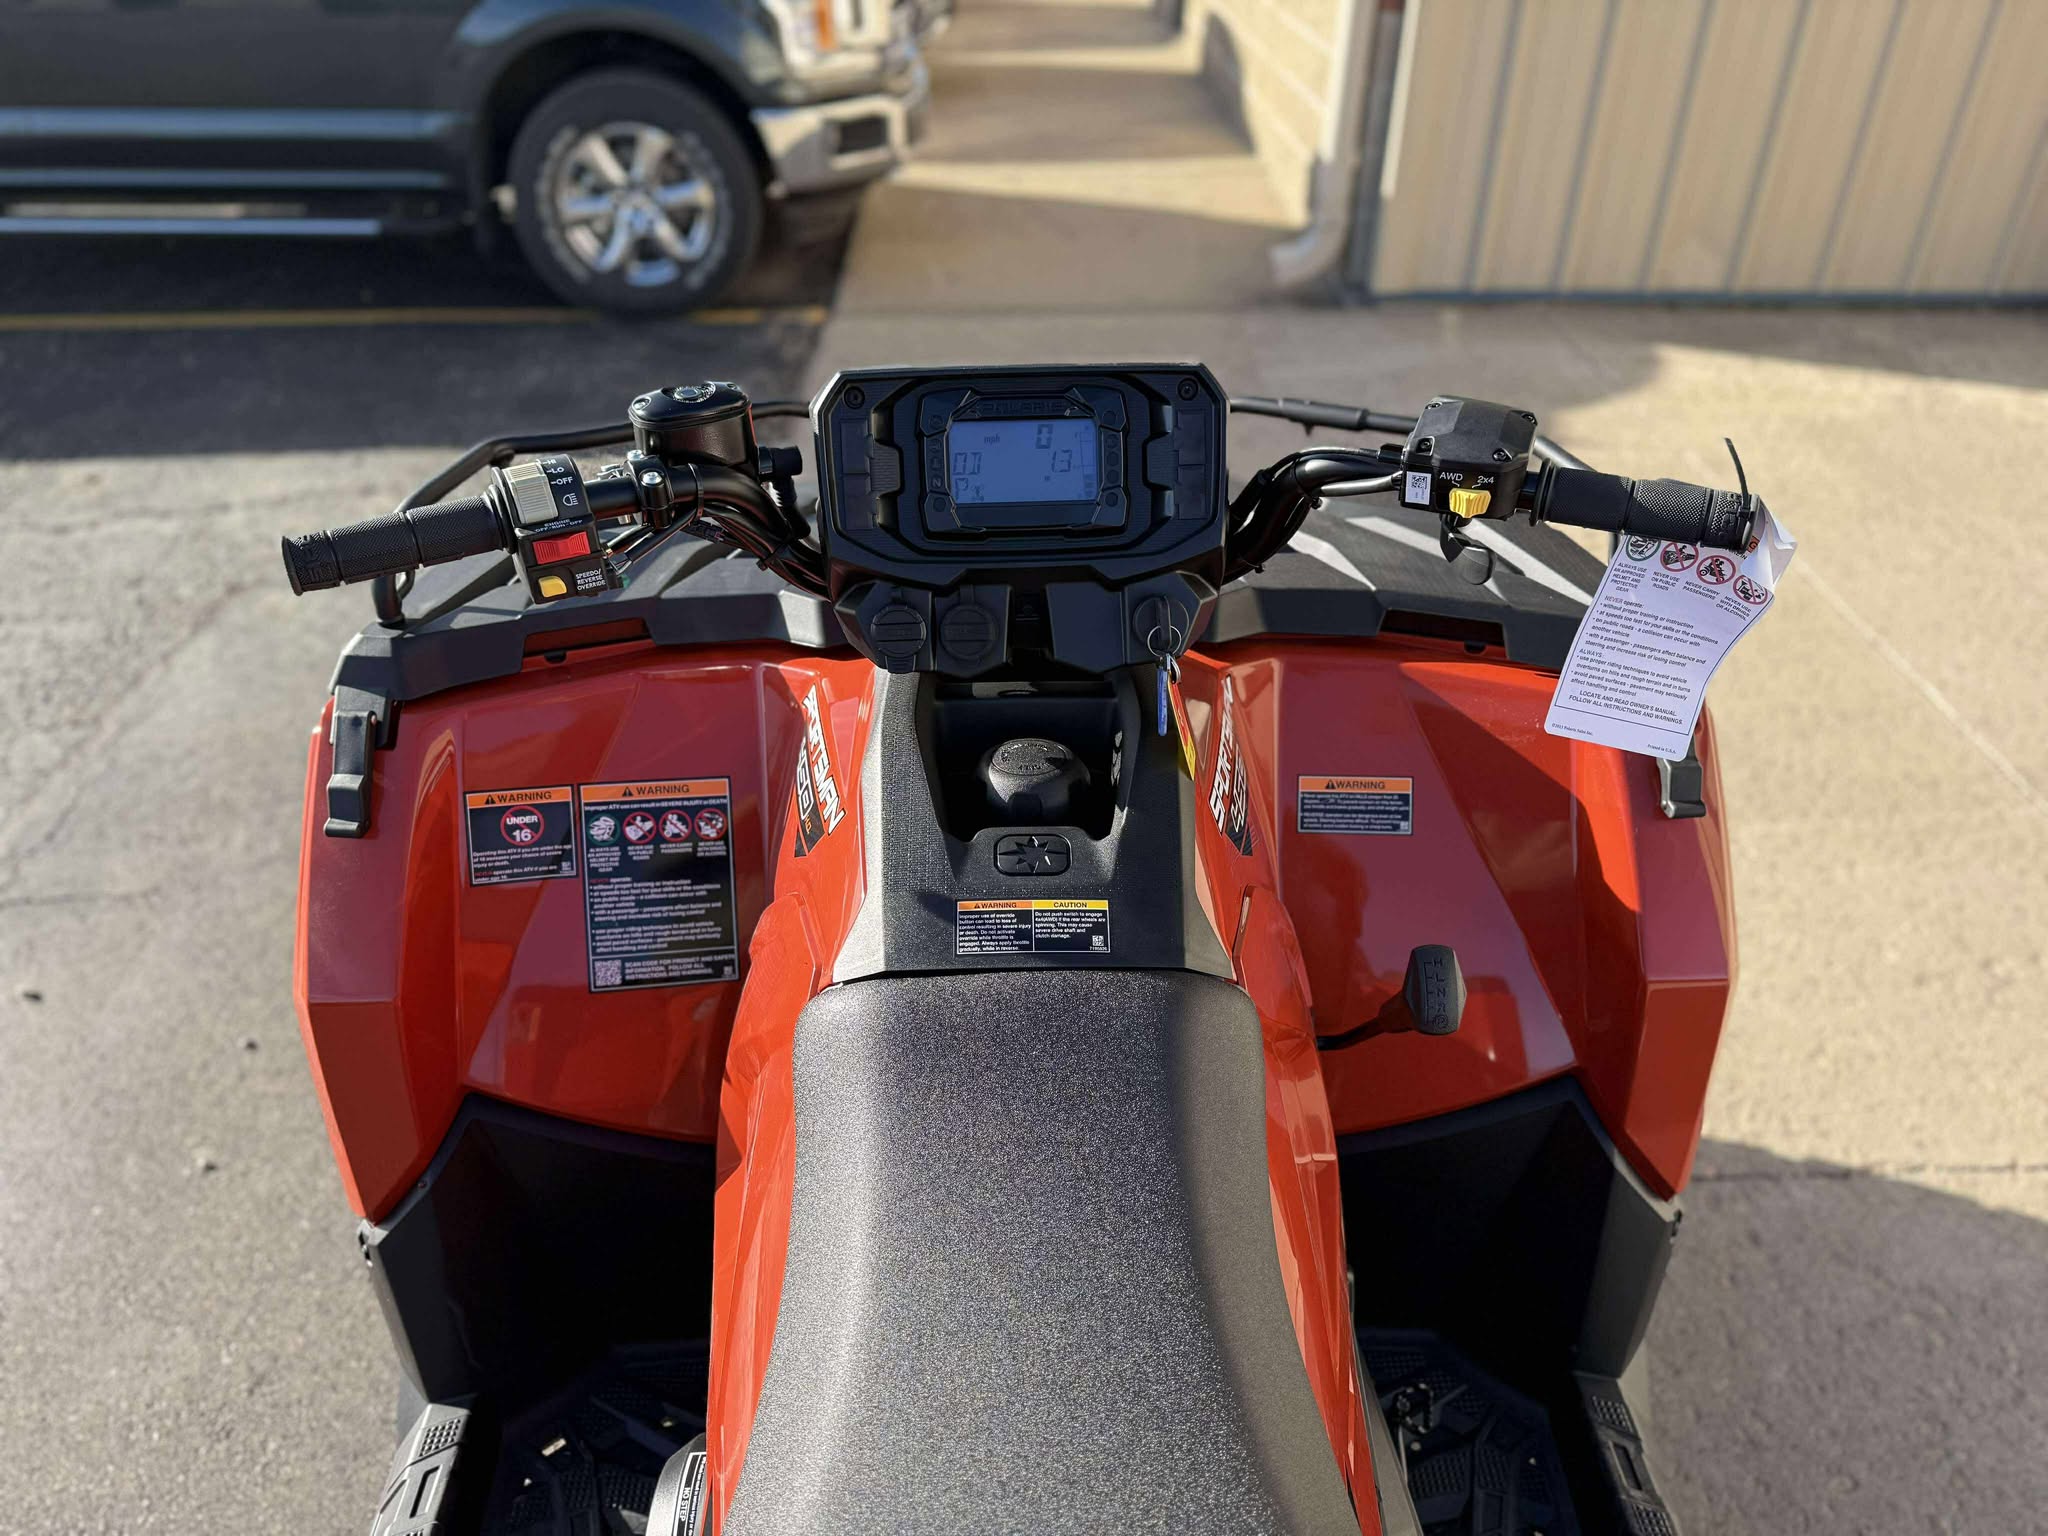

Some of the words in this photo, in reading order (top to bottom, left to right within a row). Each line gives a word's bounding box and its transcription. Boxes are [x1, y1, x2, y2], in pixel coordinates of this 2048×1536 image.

[984, 433, 1000, 445] mph
[1035, 424, 1054, 449] 0
[556, 476, 573, 485] OFF
[1440, 472, 1464, 481] AWD
[1477, 476, 1494, 484] 2x4
[575, 568, 601, 579] SPEEDO/
[576, 574, 604, 585] REVERSE
[576, 579, 606, 591] OVERRIDE
[1604, 595, 1623, 604] NEVER
[1623, 600, 1644, 608] operate:
[1602, 603, 1623, 611] without
[1621, 607, 1639, 615] proper
[1639, 611, 1659, 621] training
[1665, 618, 1694, 629] instruction
[1591, 625, 1612, 633] another
[1611, 630, 1630, 638] vehicle
[1605, 612, 1624, 620] speeds
[1690, 633, 1719, 645] conditions
[1641, 628, 1663, 638] collision
[1584, 640, 1606, 650] steering
[1615, 647, 1637, 656] increase
[1652, 655, 1668, 664] losing
[1668, 659, 1687, 667] control
[1603, 636, 1630, 646] passenger
[1632, 643, 1661, 654] passengers
[1675, 652, 1696, 662] balance
[1576, 663, 1601, 672] overturns
[1630, 675, 1646, 683] rough
[1645, 678, 1662, 686] terrain
[1606, 661, 1622, 670] riding
[1622, 664, 1650, 675] techniques
[1585, 681, 1608, 692] handling
[1618, 689, 1637, 697] control
[1604, 677, 1626, 686] surfaces
[1629, 683, 1654, 692] pavement
[1665, 691, 1688, 701] seriously
[1568, 694, 1592, 704] FOLLOW
[1603, 702, 1642, 716] INSTRUCTIONS
[1579, 689, 1602, 700] LOCATE
[1613, 697, 1629, 706] READ
[1629, 701, 1654, 712] OWNER'S
[636, 784, 690, 795] WARNING
[1335, 780, 1386, 790] WARNING
[497, 790, 552, 803] WARNING
[506, 815, 538, 825] UNDER
[512, 828, 532, 842] 16
[682, 1487, 691, 1498] NO
[679, 1500, 689, 1522] STEP
